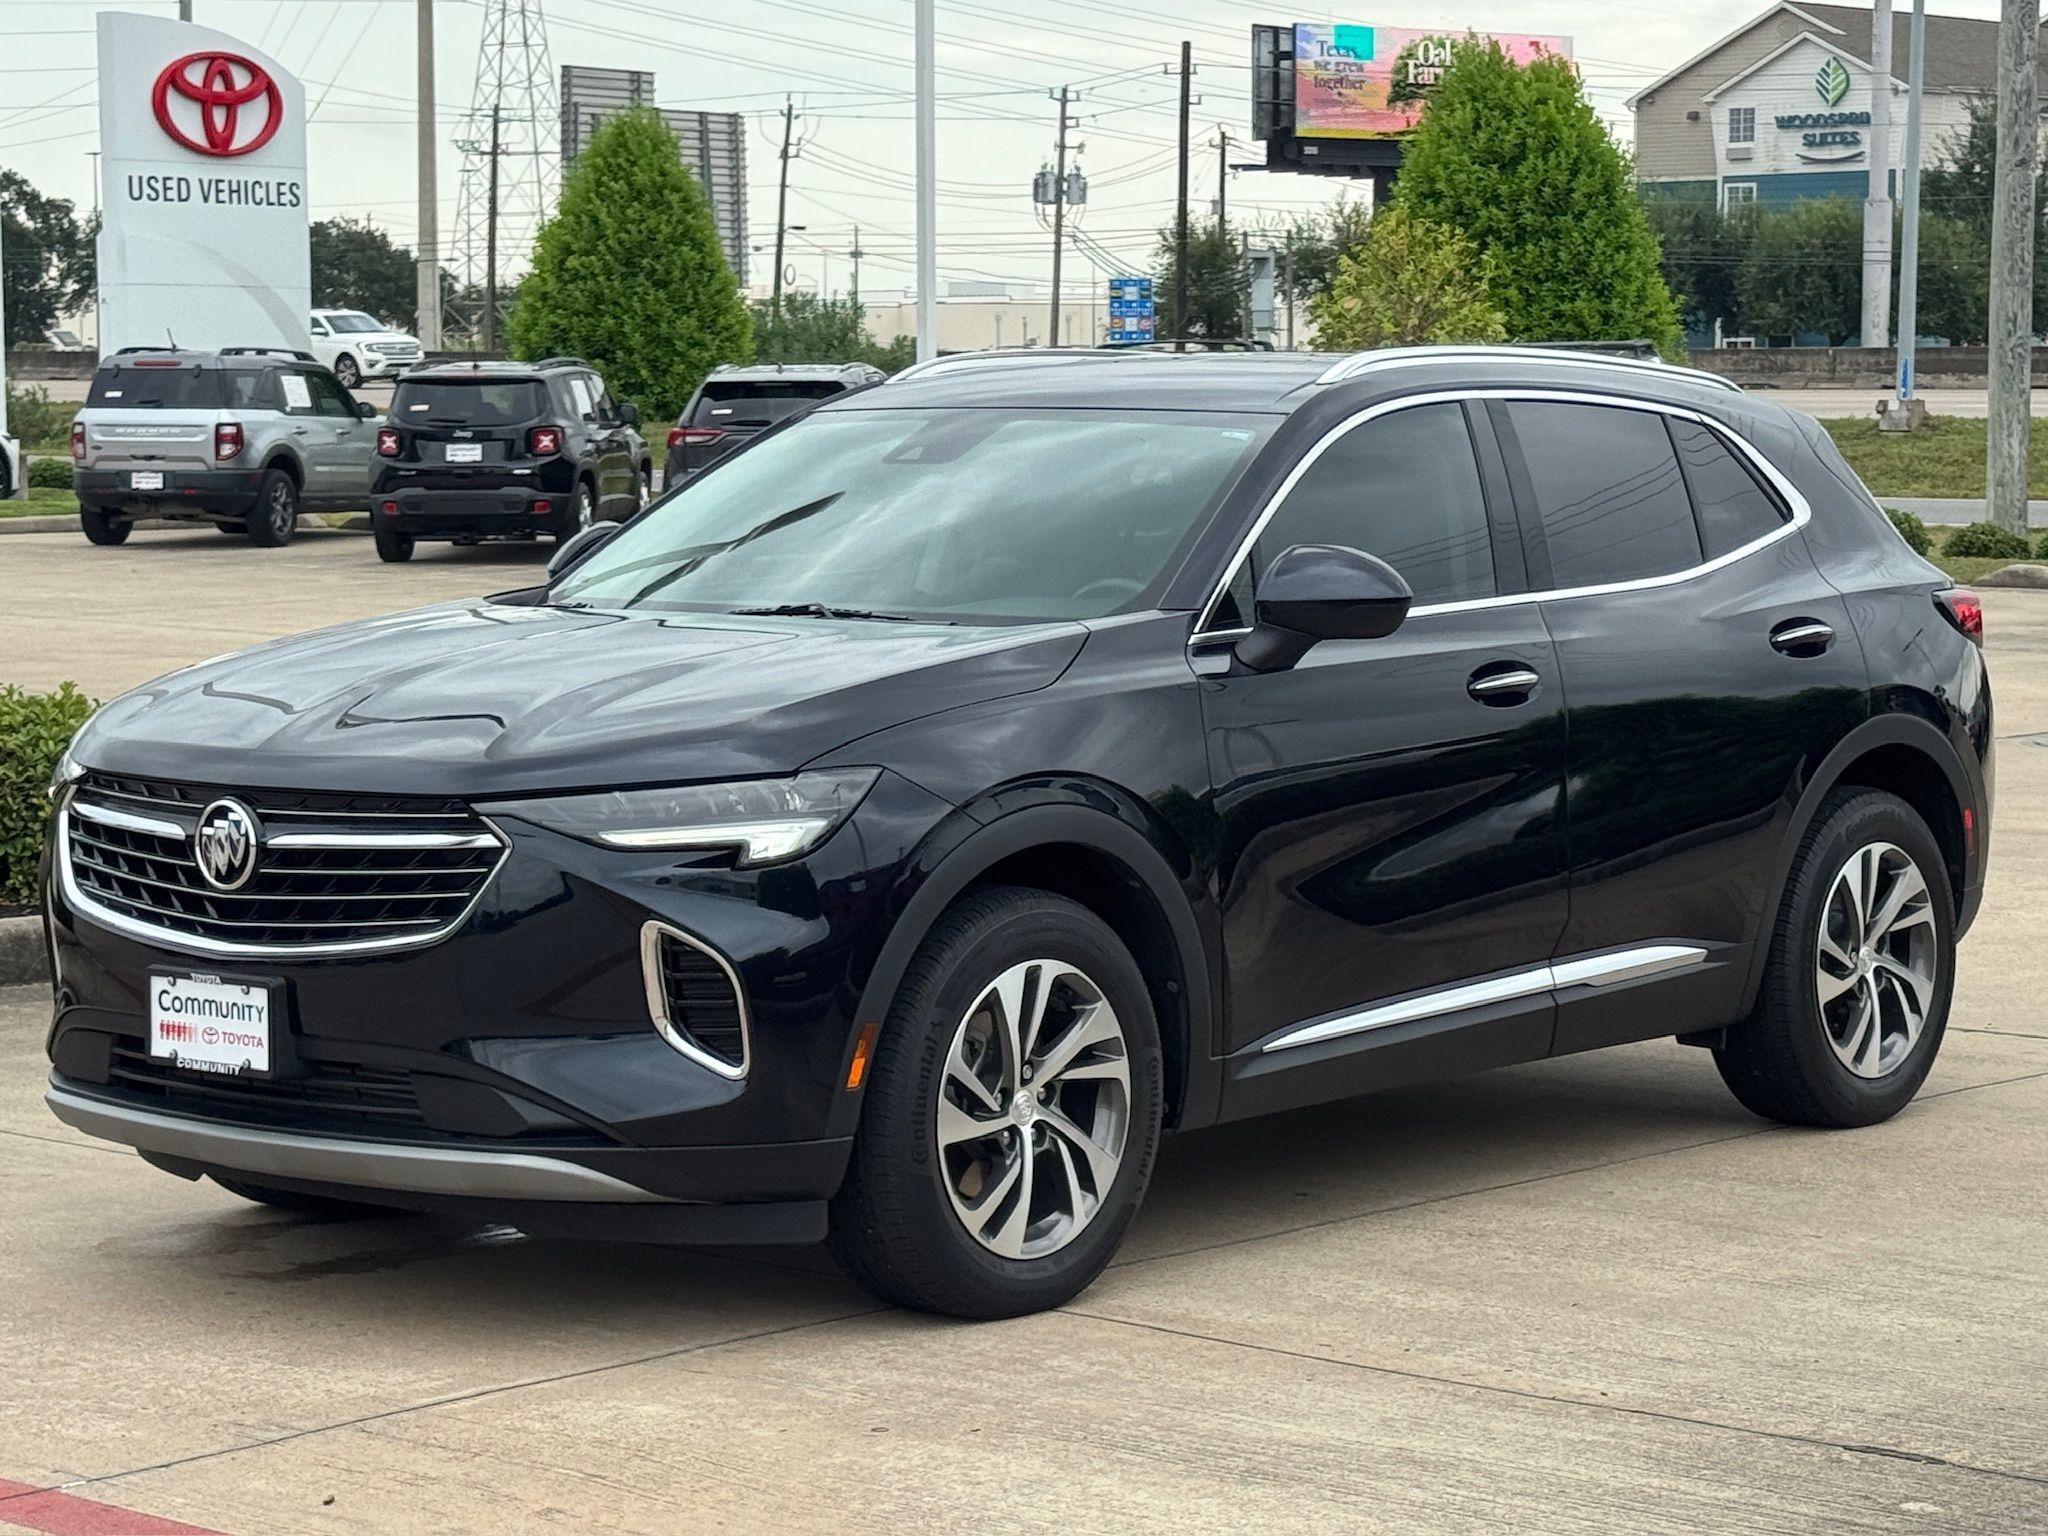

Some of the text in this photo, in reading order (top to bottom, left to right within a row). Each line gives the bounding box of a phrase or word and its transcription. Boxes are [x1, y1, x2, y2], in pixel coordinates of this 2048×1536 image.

[1405, 59, 1444, 85] Far
[1313, 75, 1366, 92] together
[1802, 131, 1861, 147] SUITES
[128, 175, 301, 208] USED VEHICLES
[190, 972, 222, 986] TOYOTA
[222, 1031, 264, 1049] TOYOTA
[176, 1057, 241, 1076] COMMUNITY
[911, 1035, 939, 1165] Continental
